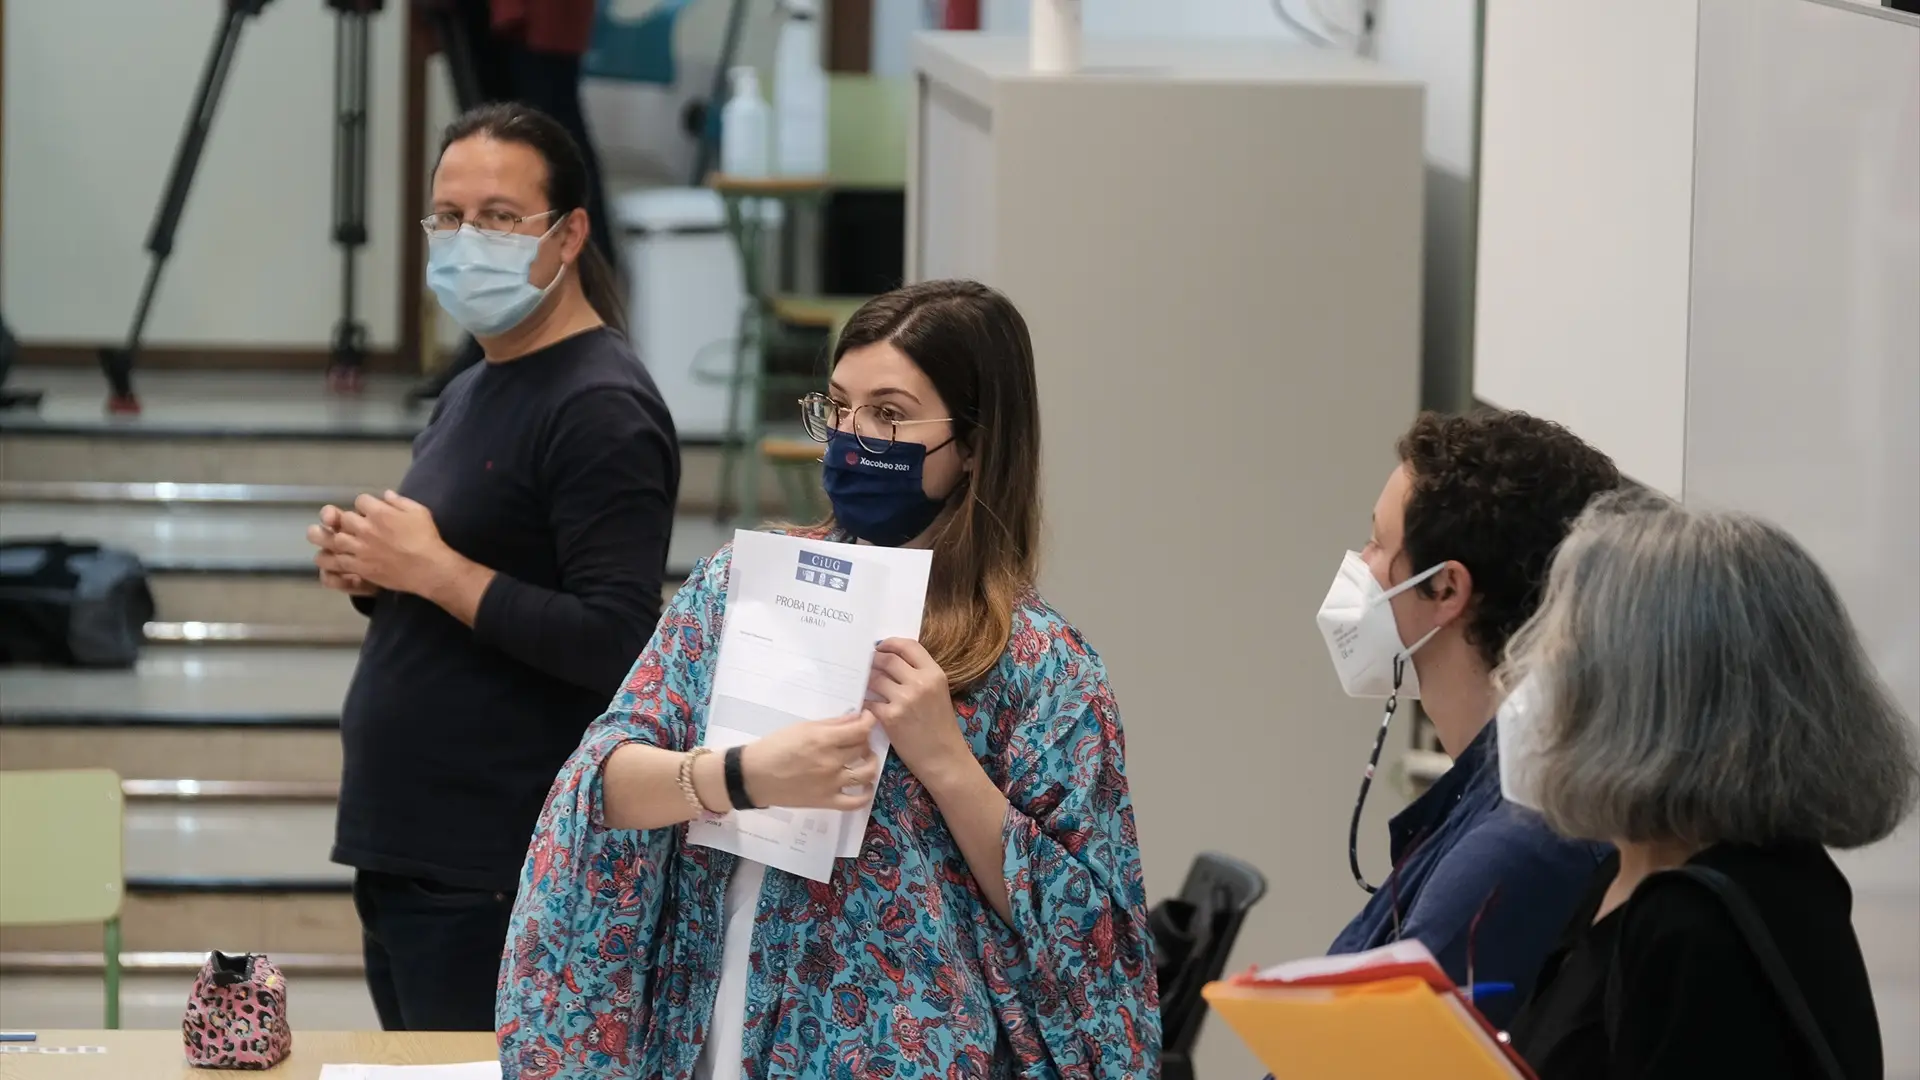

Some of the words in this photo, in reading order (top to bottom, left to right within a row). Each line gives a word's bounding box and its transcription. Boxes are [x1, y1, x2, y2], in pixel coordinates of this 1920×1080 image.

[860, 457, 893, 470] Xacobeo
[894, 463, 910, 471] 2021
[811, 555, 841, 571] CiUG
[775, 594, 805, 611] PROBA
[806, 602, 820, 615] DE
[820, 607, 854, 624] ACCESO
[800, 615, 826, 628] (ABAU)
